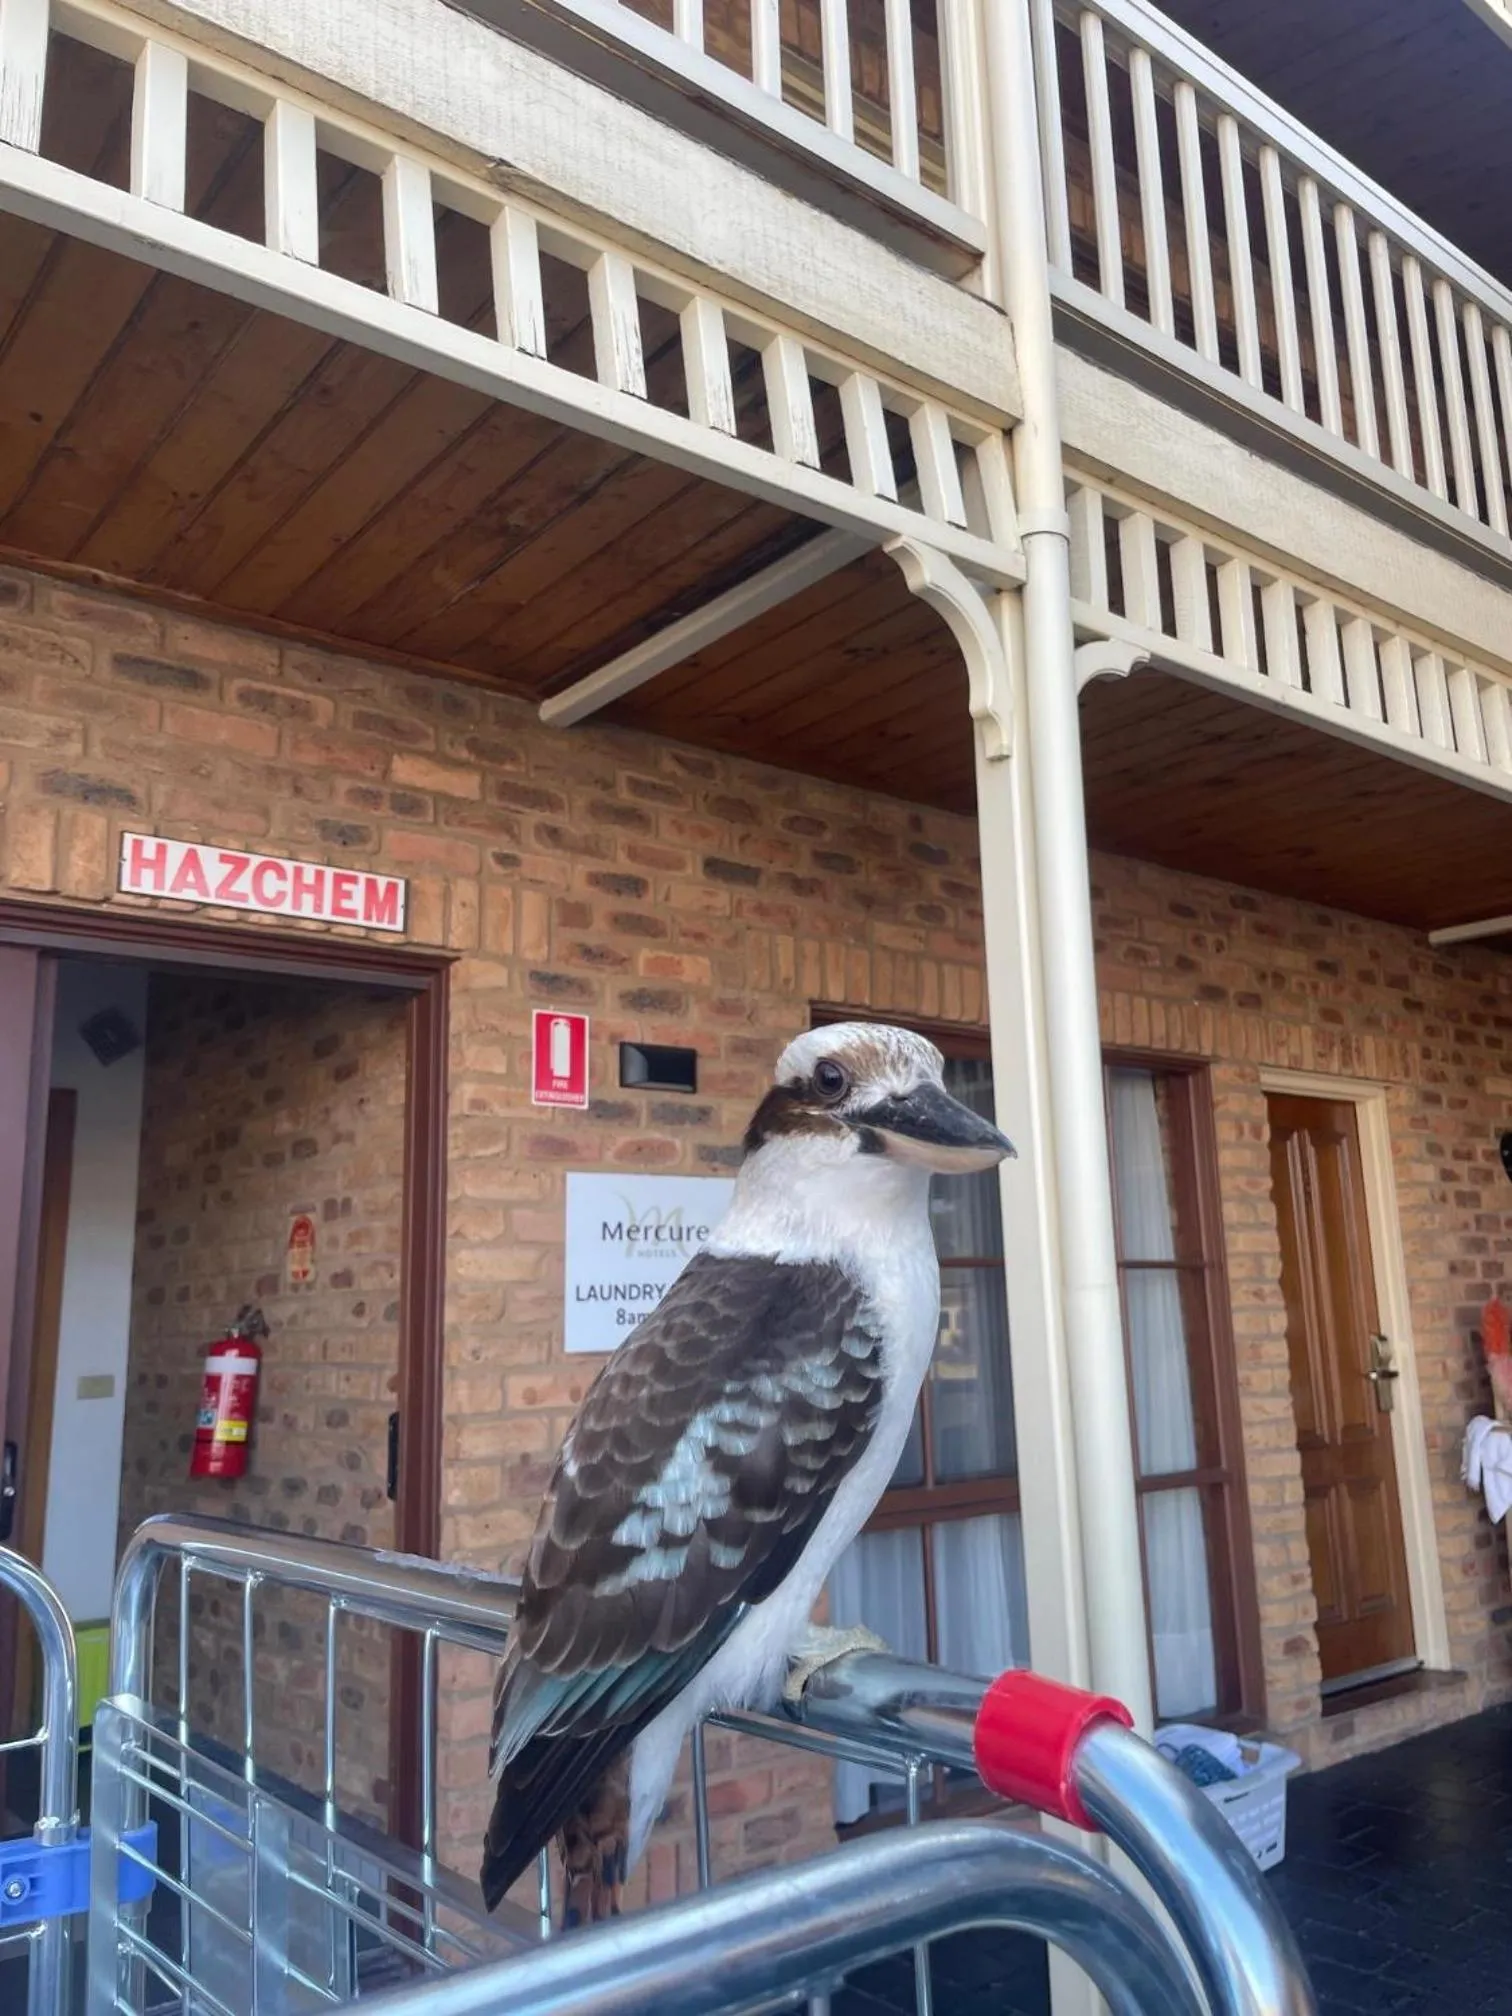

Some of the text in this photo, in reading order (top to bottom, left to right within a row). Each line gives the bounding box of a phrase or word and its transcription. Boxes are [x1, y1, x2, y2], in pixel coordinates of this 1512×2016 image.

[130, 838, 399, 925] HAZCHEM
[602, 1221, 710, 1242] Mercure
[576, 1283, 666, 1301] LAUNDRY
